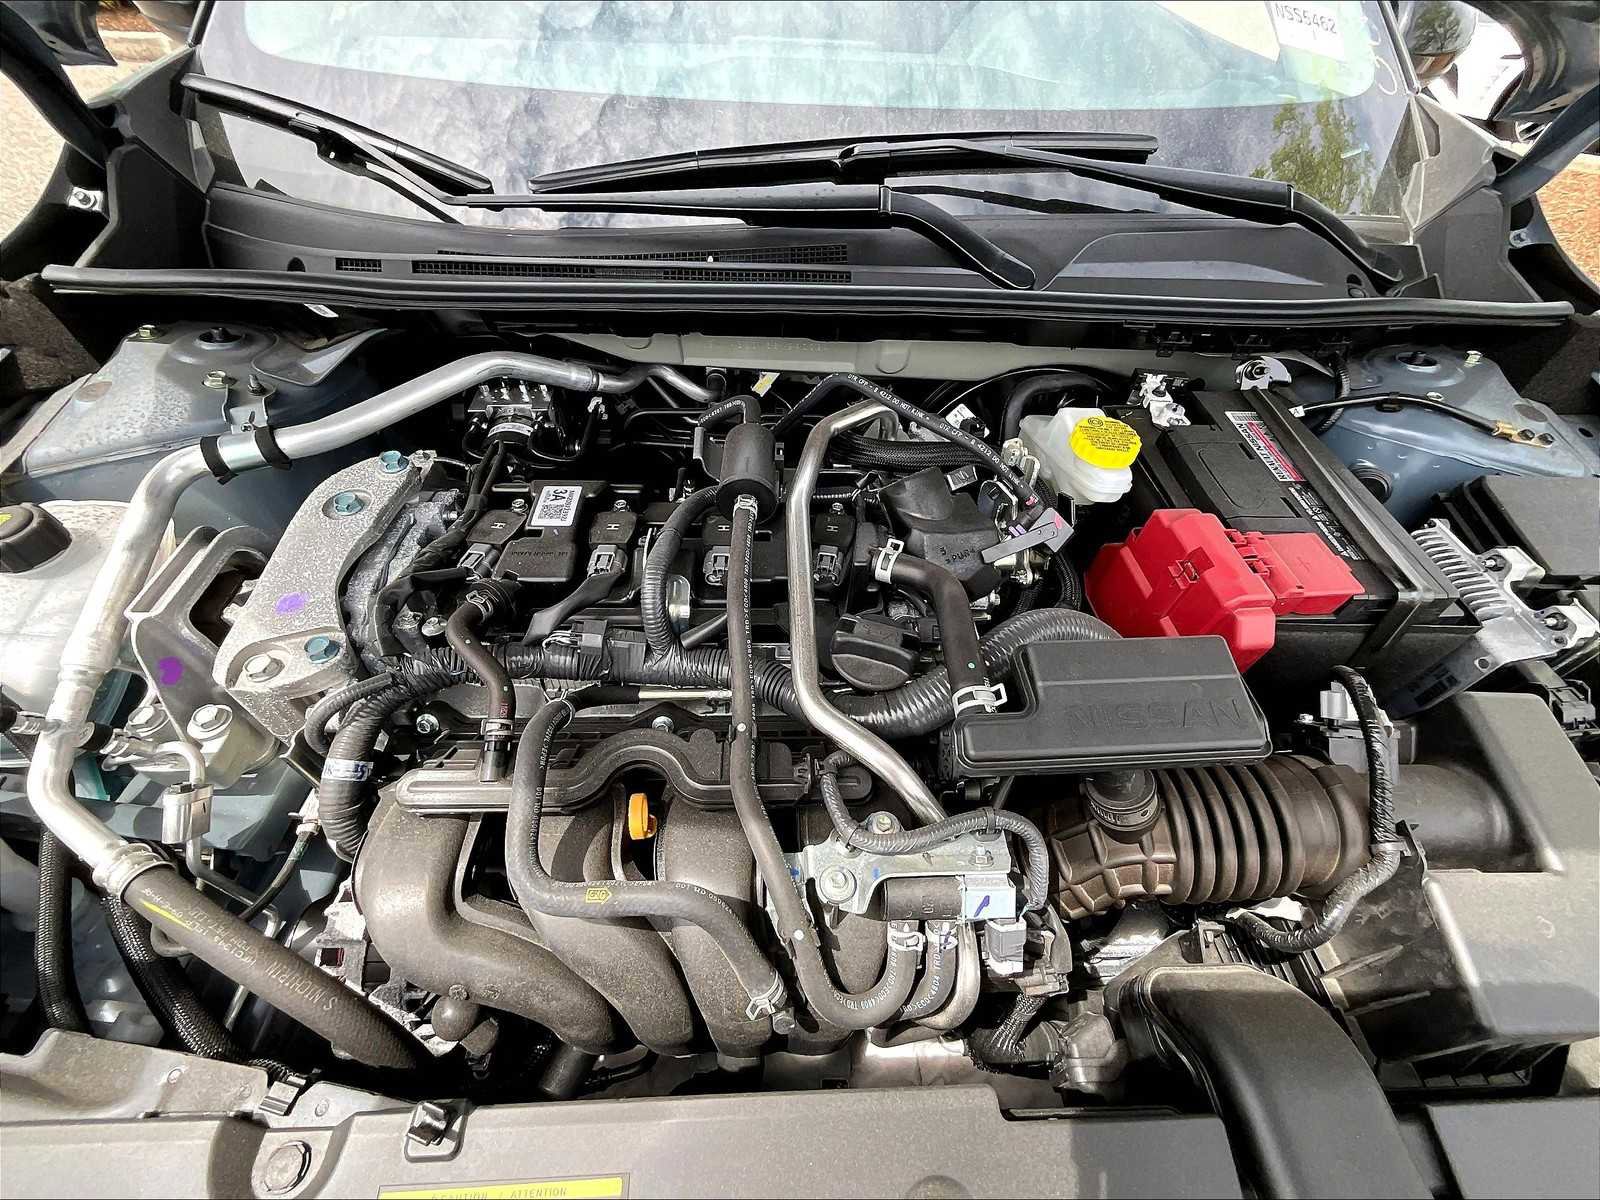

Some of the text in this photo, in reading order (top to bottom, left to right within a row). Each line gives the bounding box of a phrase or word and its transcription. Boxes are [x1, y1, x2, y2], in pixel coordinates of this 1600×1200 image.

[879, 389, 892, 402] 4212
[901, 402, 911, 411] NOT
[911, 408, 925, 420] KINK
[976, 444, 991, 457] 4212
[992, 456, 1000, 465] DO
[1000, 464, 1010, 474] NOT
[553, 487, 568, 510] 3A
[1068, 697, 1242, 729] NISSAN
[510, 1187, 567, 1199] ATTENTION
